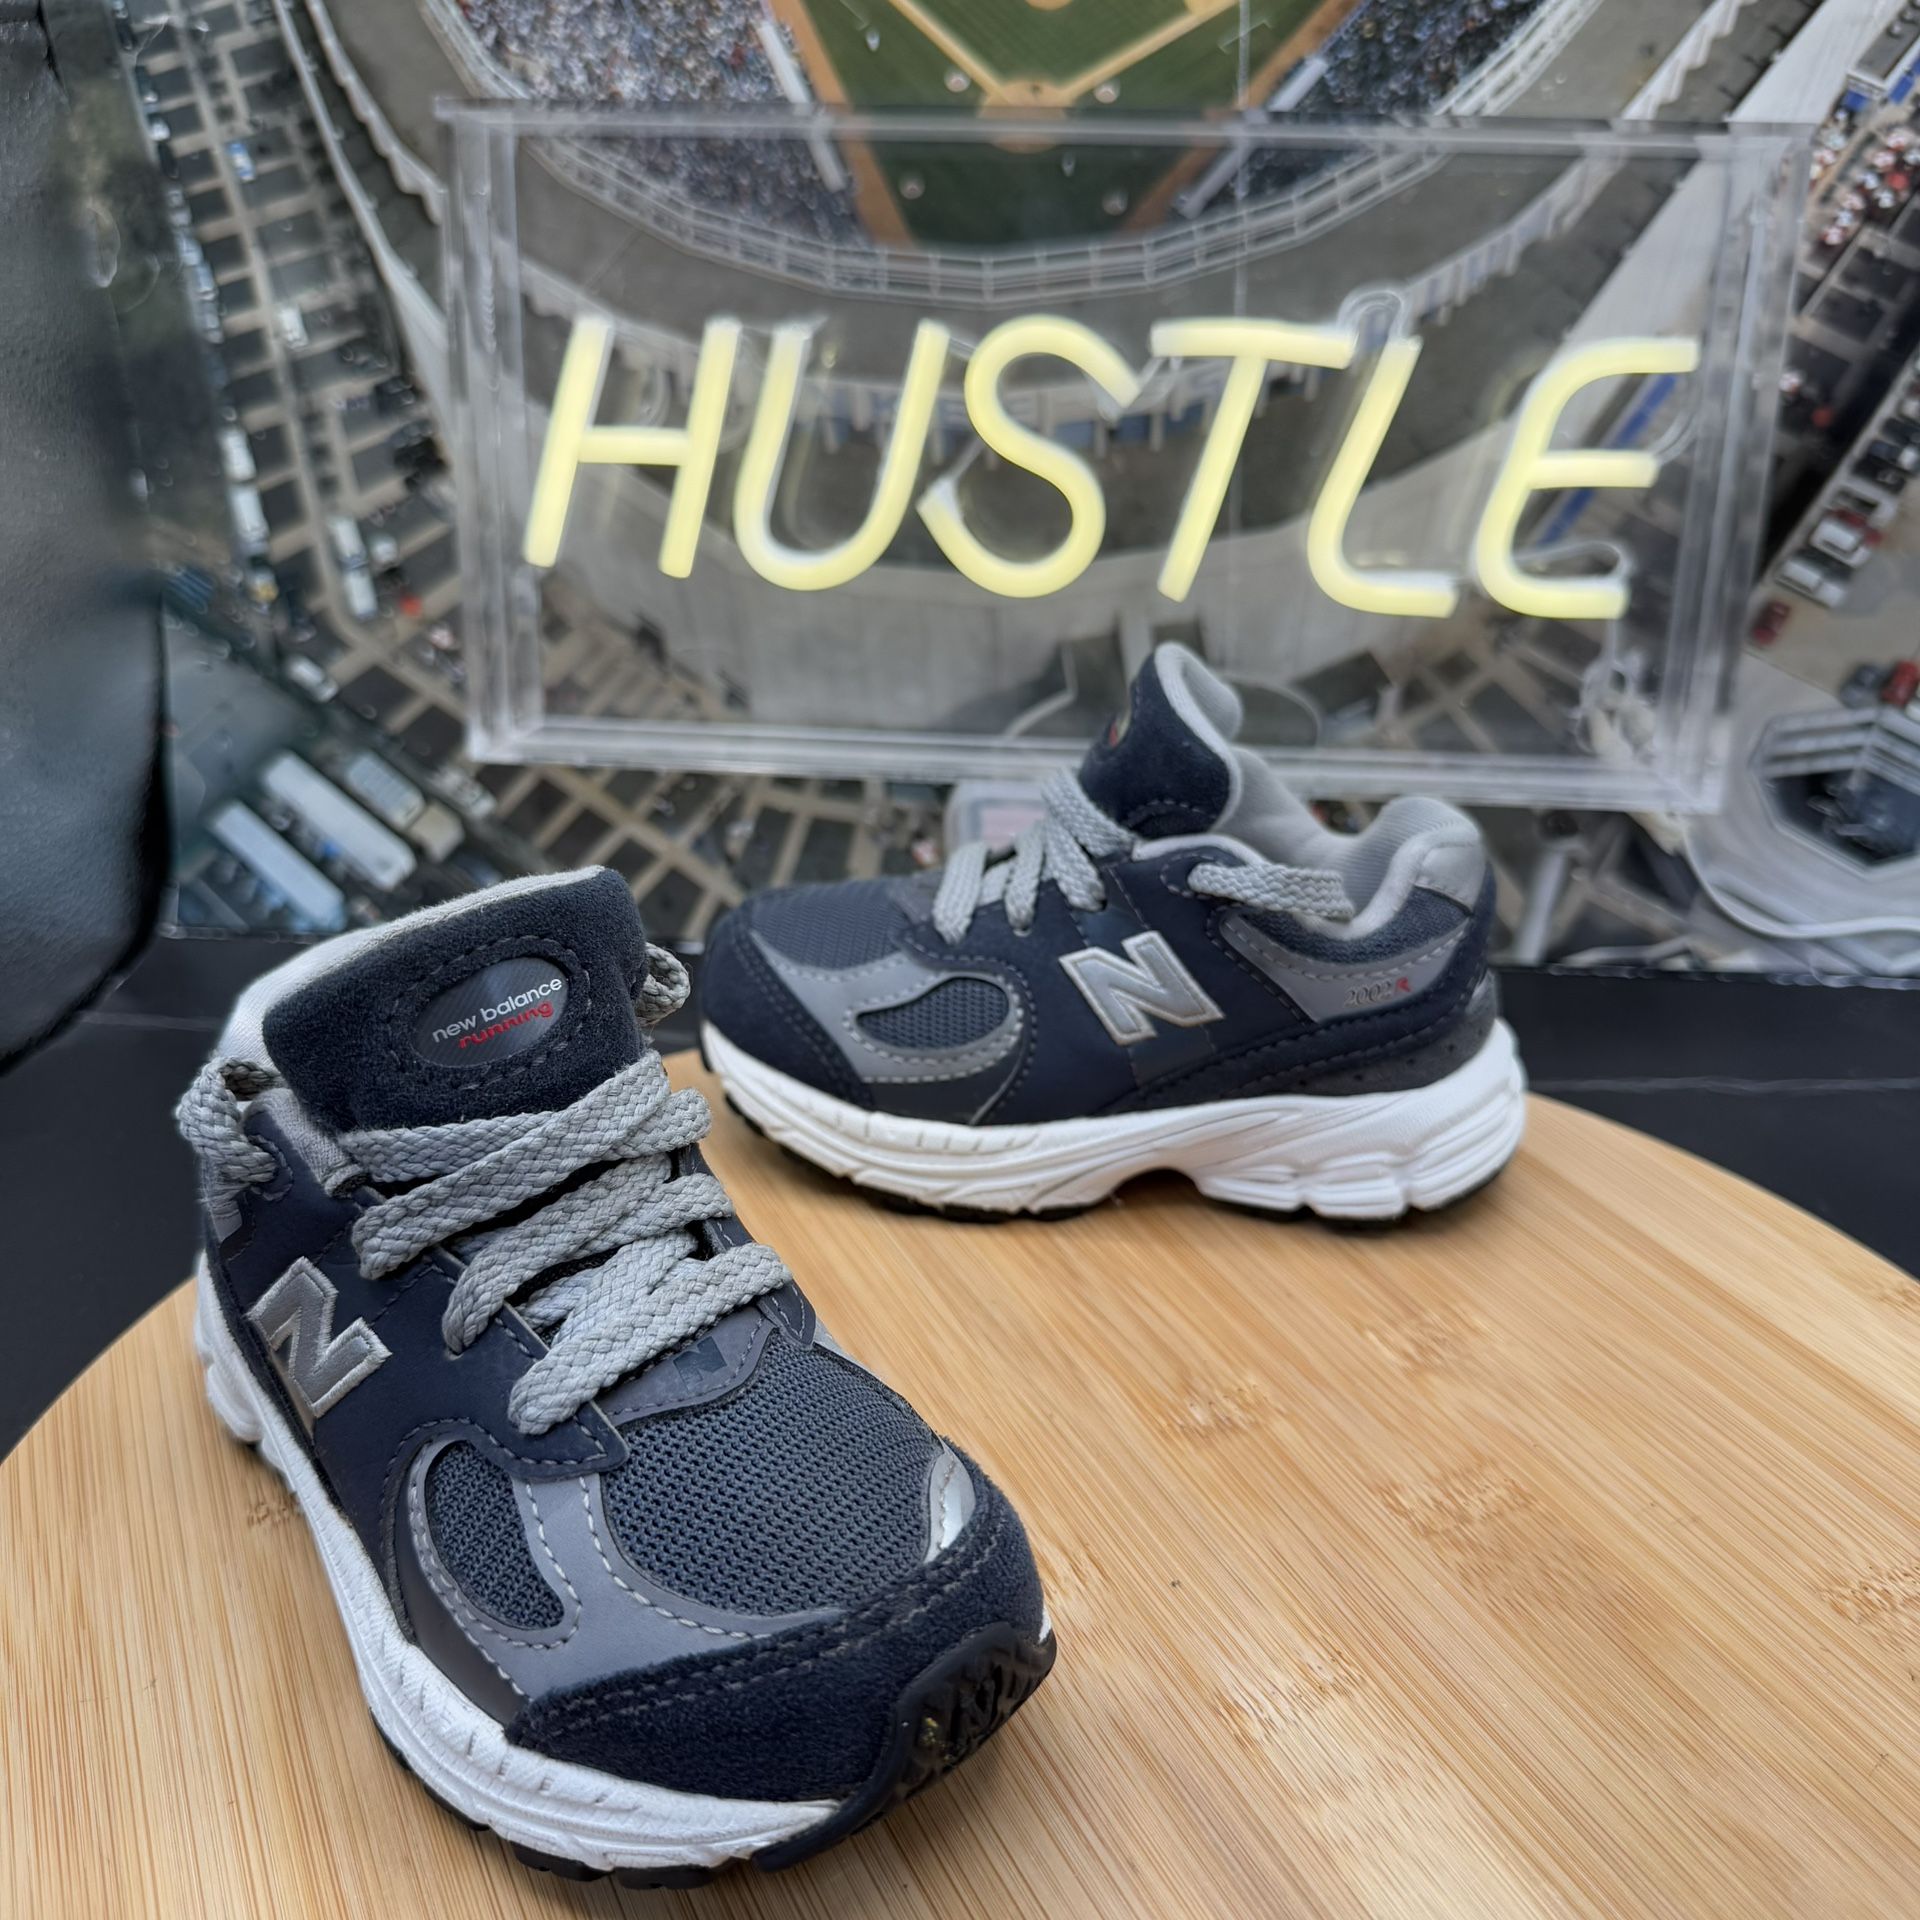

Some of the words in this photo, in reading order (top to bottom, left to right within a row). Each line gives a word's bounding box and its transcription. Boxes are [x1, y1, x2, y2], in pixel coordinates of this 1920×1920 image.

[523, 314, 1698, 618] HUSTLE
[432, 1015, 477, 1043] new
[480, 978, 562, 1022] balance
[458, 1002, 554, 1048] running
[1058, 930, 1224, 1046] N
[246, 1256, 392, 1418] N
